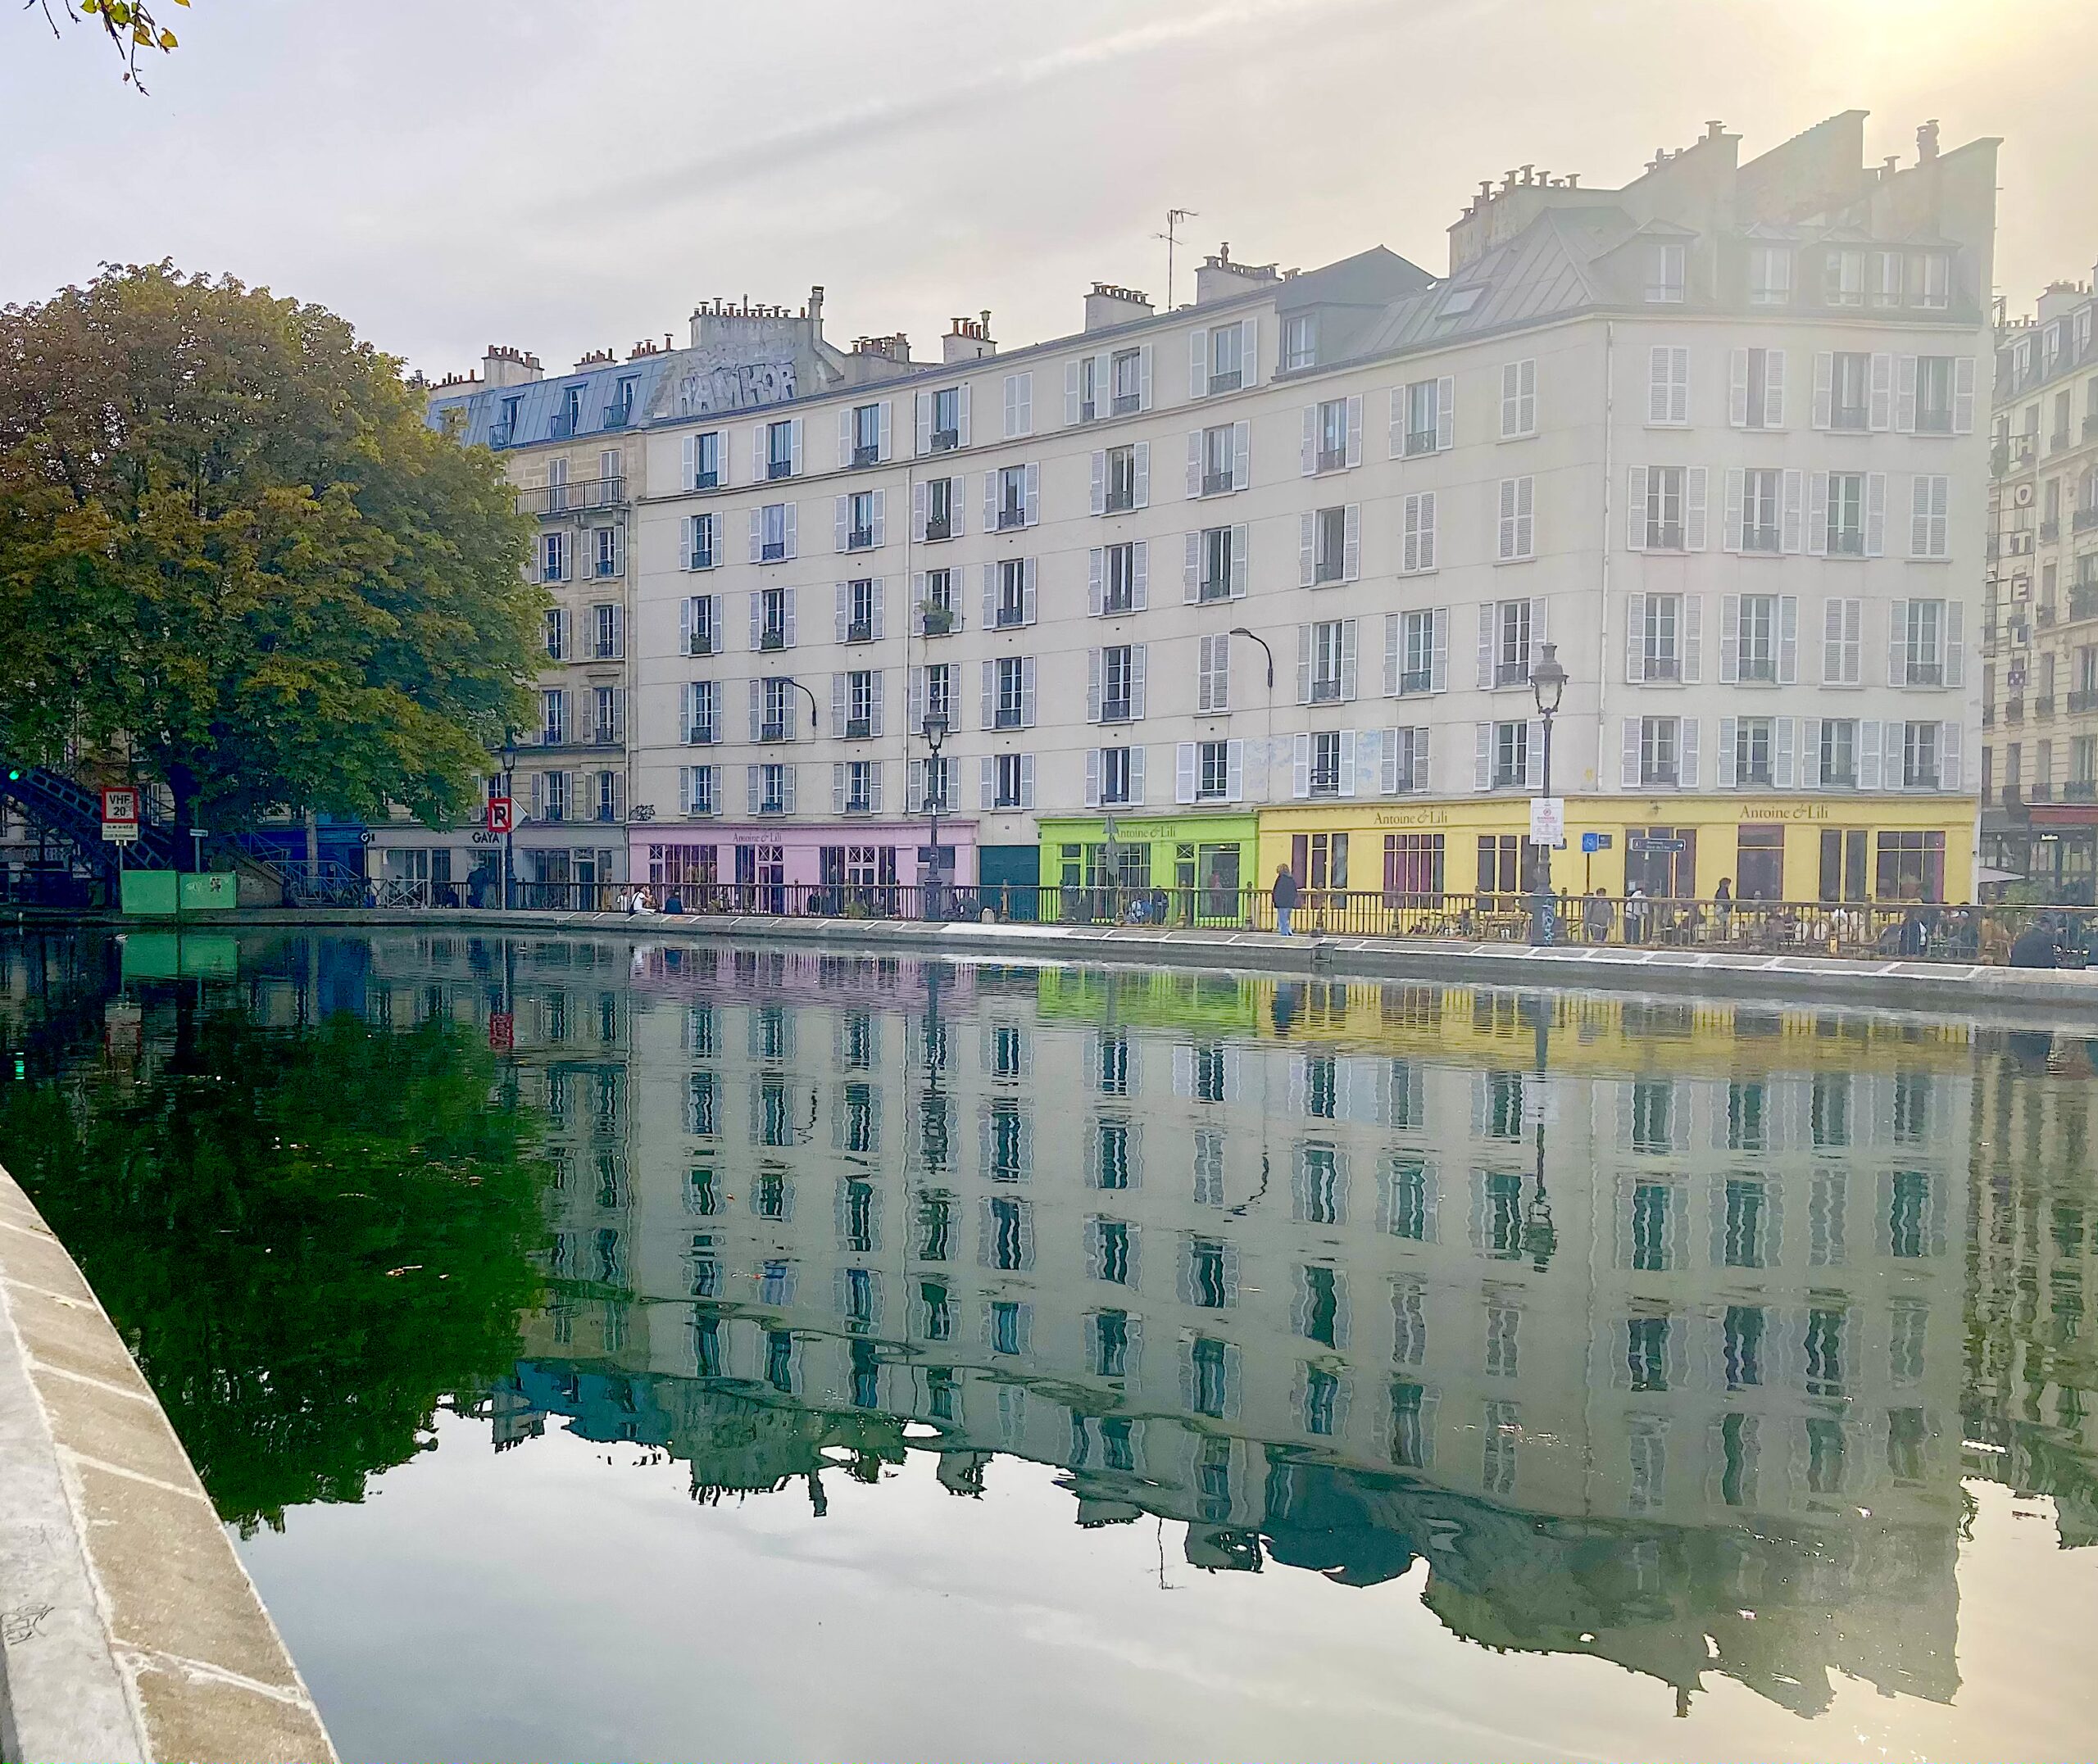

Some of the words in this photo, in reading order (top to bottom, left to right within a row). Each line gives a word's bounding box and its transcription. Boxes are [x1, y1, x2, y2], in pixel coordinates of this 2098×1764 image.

[2011, 436, 2033, 649] HOTEL
[109, 795, 131, 805] VHF
[113, 806, 126, 817] 20
[1374, 812, 1415, 825] Antoine
[1430, 810, 1448, 824] Lili
[1740, 805, 1790, 819] Antoine
[1807, 804, 1828, 819] Lili
[472, 832, 500, 844] GAYA
[733, 832, 760, 842] Antoine
[770, 832, 782, 842] Lili
[1115, 828, 1147, 838] Antoine
[1160, 826, 1176, 838] Lili
